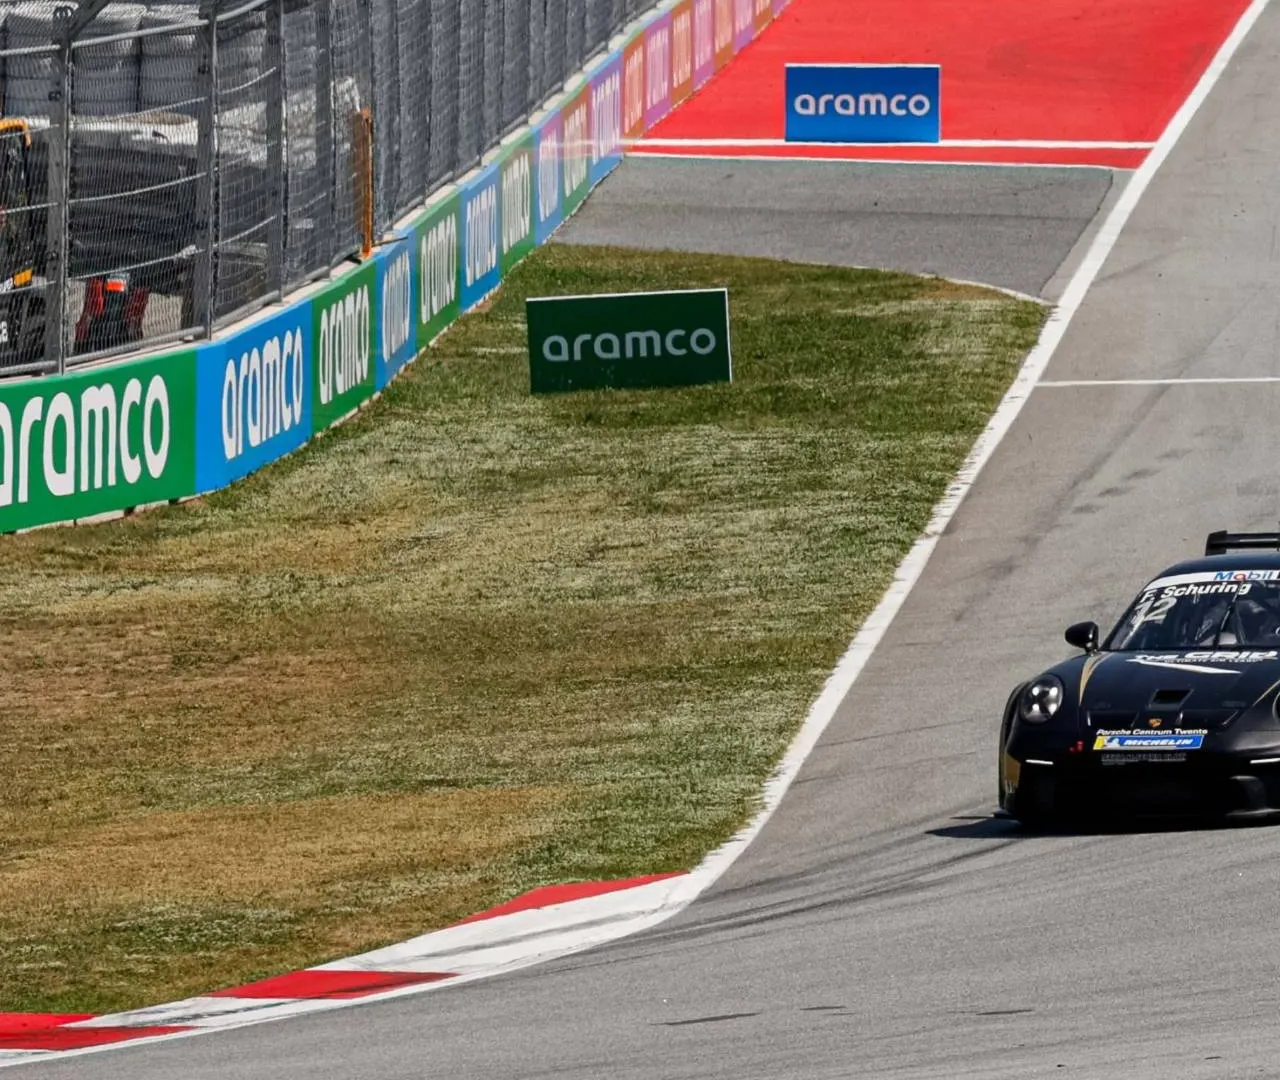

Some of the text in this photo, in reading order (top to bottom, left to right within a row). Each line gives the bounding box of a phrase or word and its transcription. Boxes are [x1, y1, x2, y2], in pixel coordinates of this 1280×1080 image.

[794, 92, 931, 117] aramco
[319, 284, 370, 405] aramco
[542, 326, 718, 363] aramco
[221, 325, 302, 461] aramco
[1213, 571, 1273, 581] Mobil
[1139, 581, 1252, 603] F. Schuring
[1130, 596, 1178, 627] 12
[1095, 727, 1209, 737] Porsche Centrum Twente
[1123, 737, 1194, 747] MICHELIN
